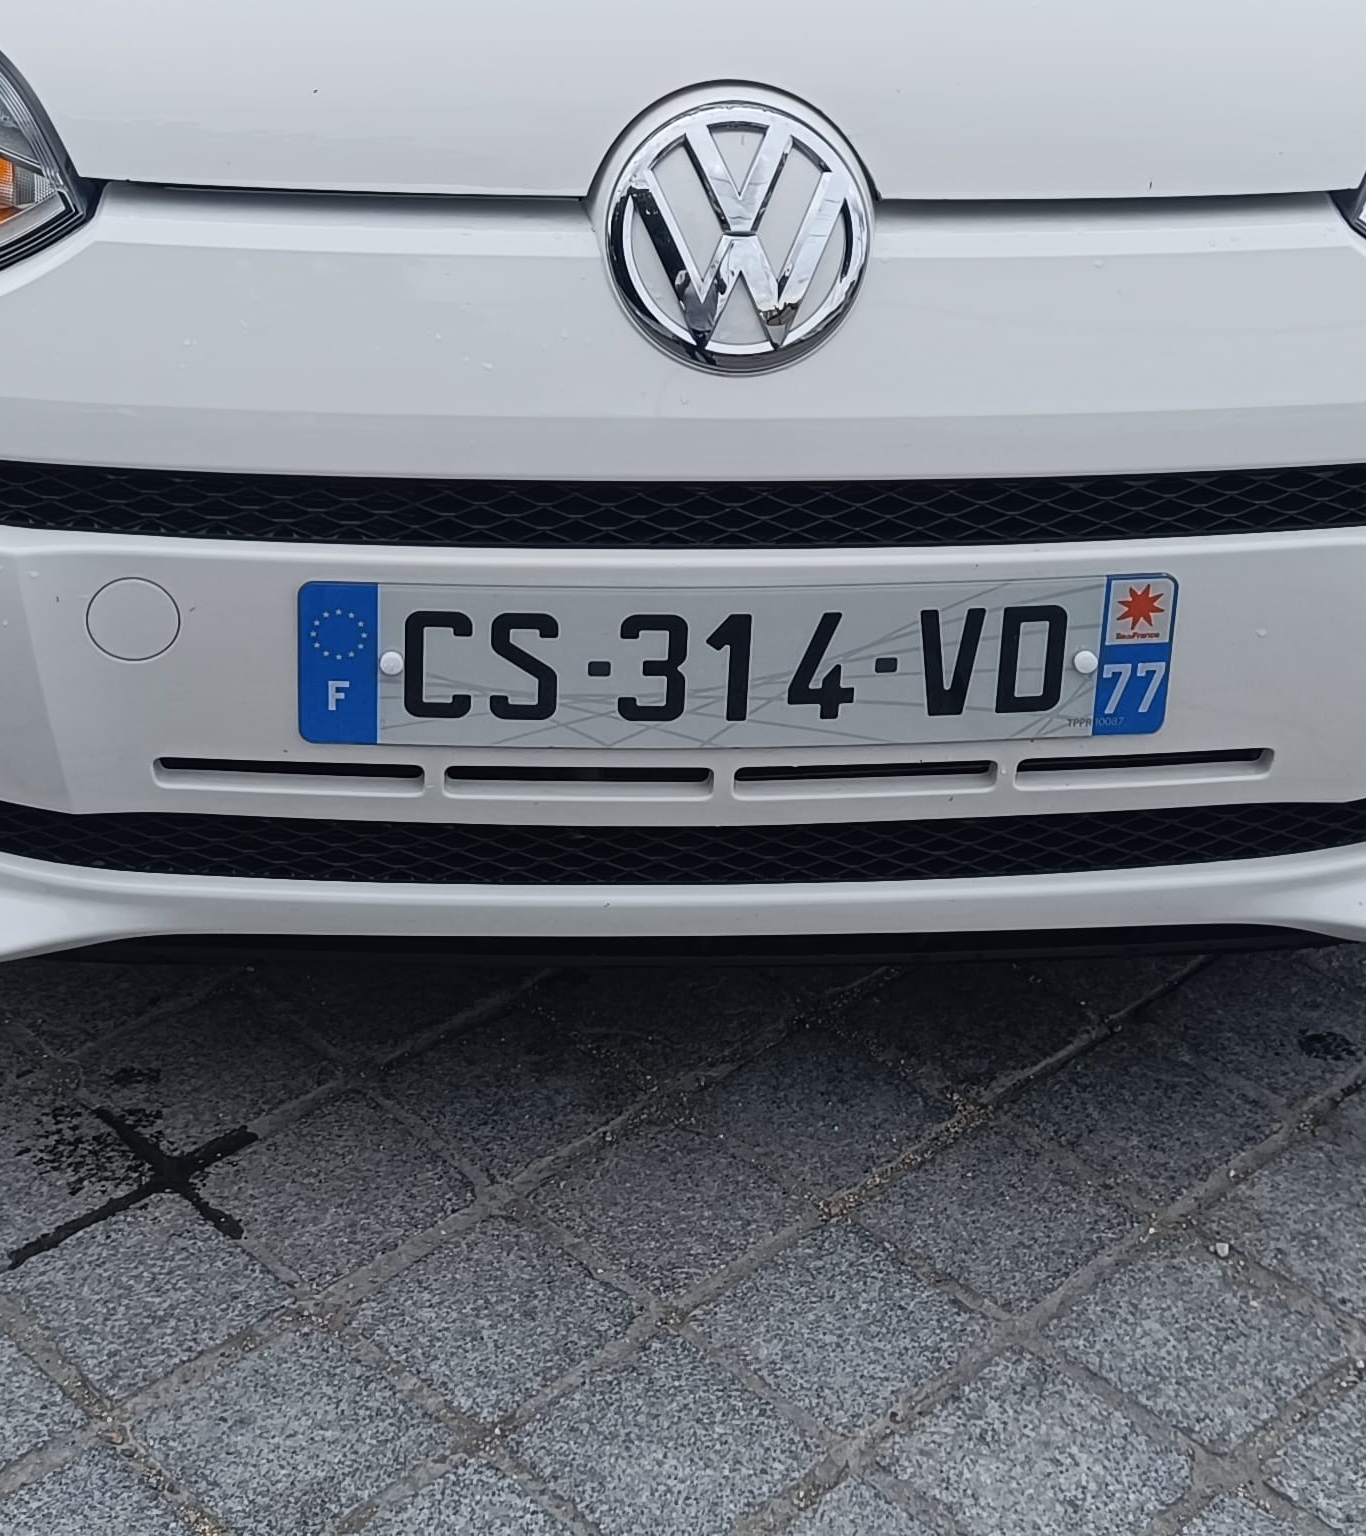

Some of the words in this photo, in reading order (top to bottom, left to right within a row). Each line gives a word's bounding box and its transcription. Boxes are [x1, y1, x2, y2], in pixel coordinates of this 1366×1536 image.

[403, 604, 1068, 722] CS-314-VD
[1102, 661, 1167, 714] 77
[327, 680, 350, 711] F
